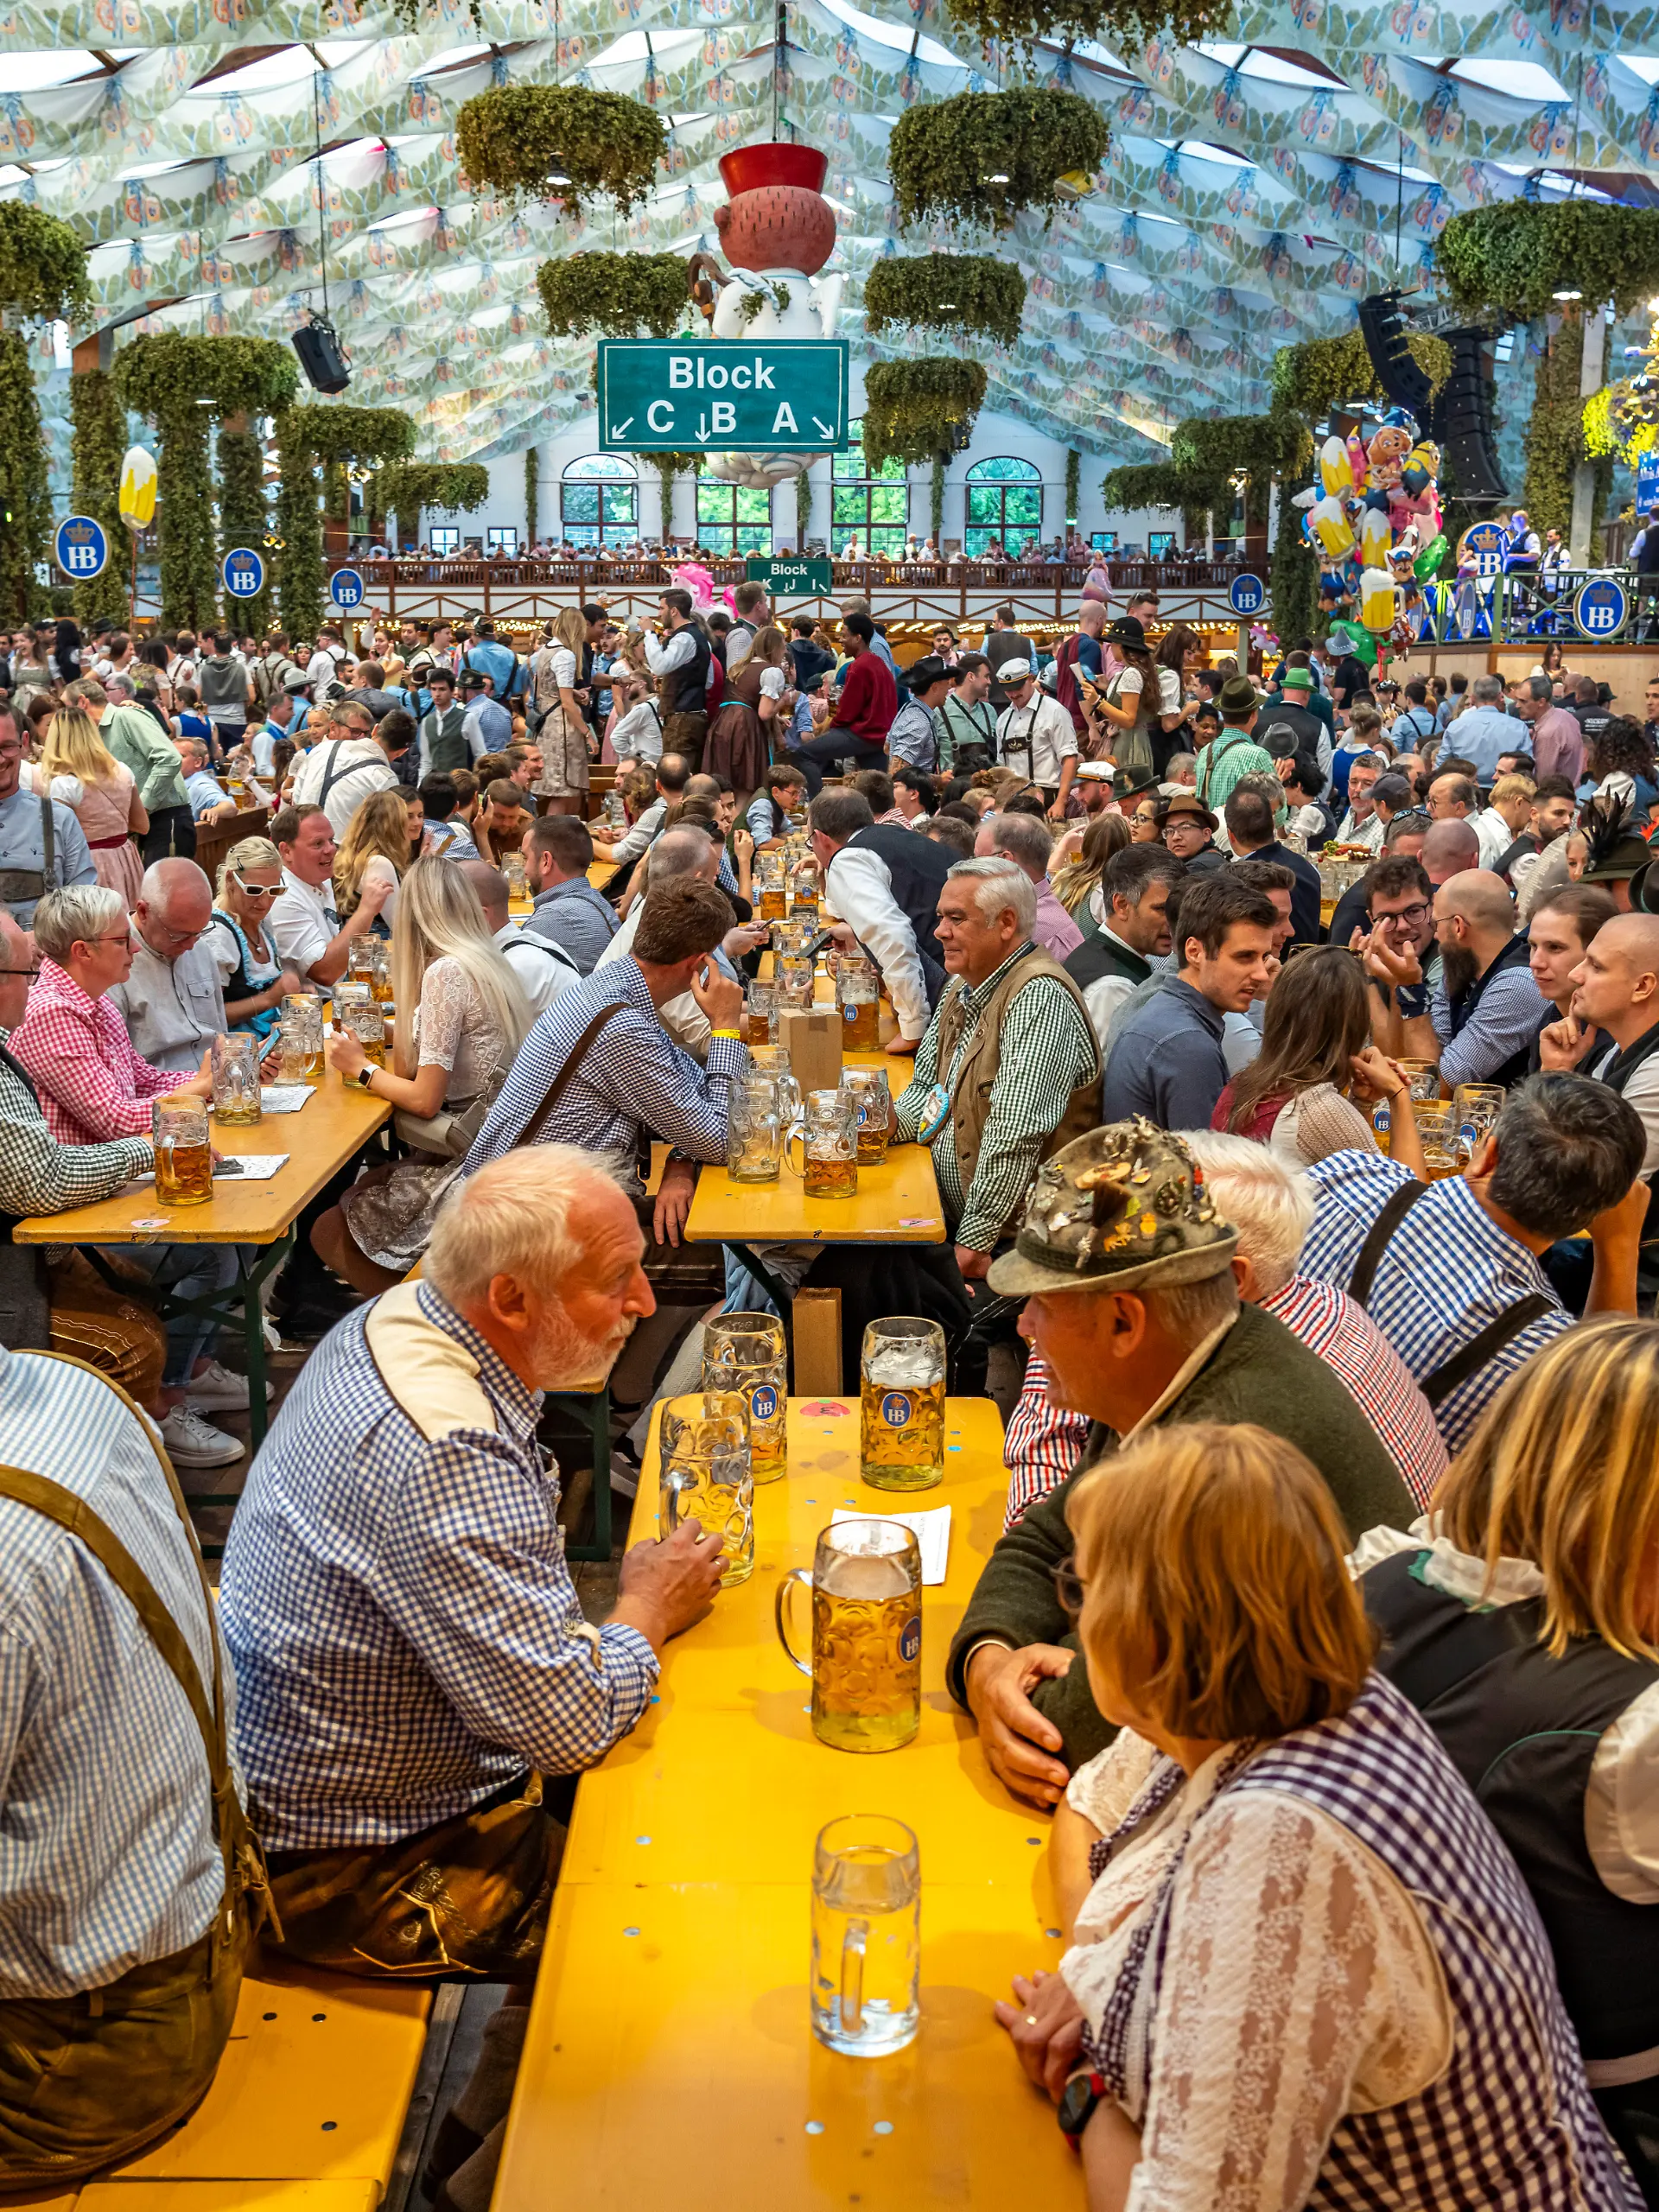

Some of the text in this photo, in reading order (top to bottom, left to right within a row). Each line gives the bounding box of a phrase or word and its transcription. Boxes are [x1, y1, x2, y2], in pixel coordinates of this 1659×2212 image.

[670, 357, 776, 389] Block
[646, 399, 799, 433] C B A
[67, 546, 98, 569] HB
[1474, 553, 1502, 575] HB
[771, 563, 808, 575] Block
[232, 572, 257, 590] HB
[762, 579, 772, 589] K
[789, 579, 796, 590] J
[338, 588, 358, 603] HB
[1237, 594, 1256, 608] HB
[1587, 607, 1615, 628] HB
[1378, 1120, 1389, 1129] HB
[758, 1401, 773, 1416] HB
[887, 1408, 906, 1422] HB
